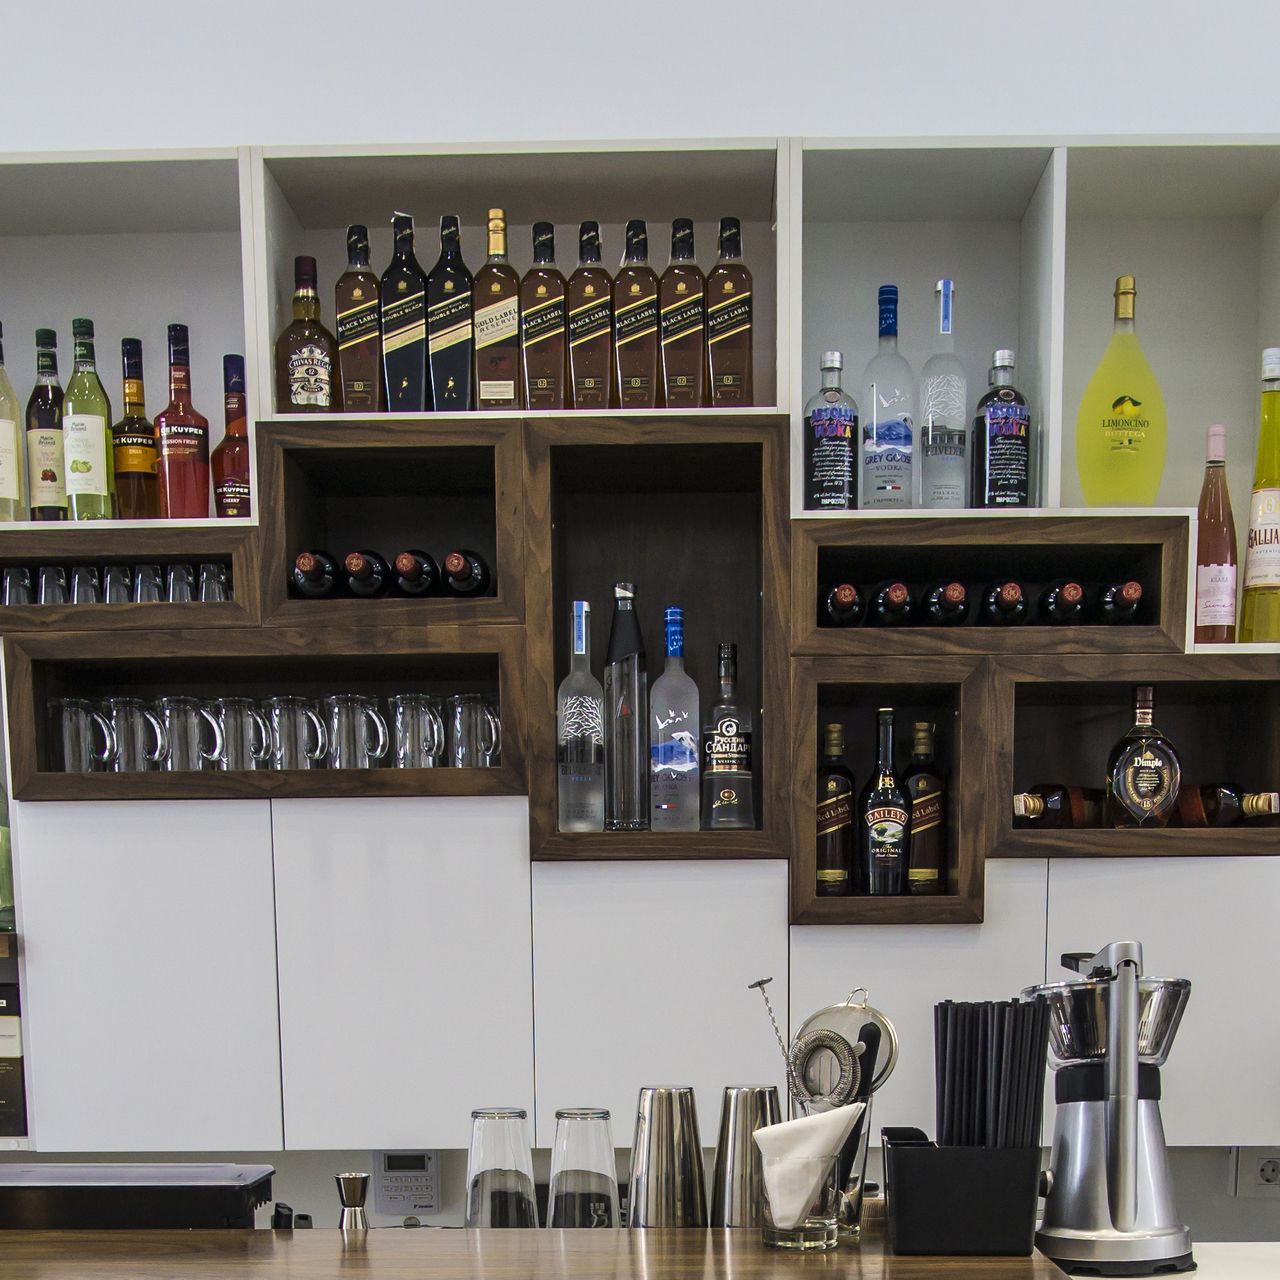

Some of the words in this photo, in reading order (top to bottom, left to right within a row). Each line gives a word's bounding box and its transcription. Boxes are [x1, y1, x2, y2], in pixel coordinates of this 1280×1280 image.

[451, 303, 470, 313] BLACK
[338, 320, 359, 333] BLACK
[359, 312, 378, 325] LABEL
[474, 317, 494, 329] GOLD
[494, 308, 518, 321] LABEL
[523, 318, 542, 329] BLACK
[542, 310, 562, 321] LABEL
[569, 316, 590, 329] BLACK
[590, 309, 610, 320] LABEL
[616, 316, 636, 328] BLACK
[636, 308, 656, 319] LABEL
[662, 315, 682, 327] BLACK
[682, 306, 703, 318] LABEL
[709, 313, 729, 327] BLACK
[730, 305, 749, 317] LABEL
[480, 315, 516, 333] RESERVE
[289, 358, 313, 369] CHIVAS
[313, 359, 332, 371] REGAL
[812, 407, 855, 421] ABSOLUT
[171, 425, 203, 435] KUYPER
[1102, 418, 1150, 428] LIMONCINO
[815, 424, 853, 438] VODKA
[121, 437, 153, 445] KUYPER
[864, 454, 884, 466] GREY
[885, 453, 913, 465] GOOSE
[875, 464, 903, 472] VODKA
[1133, 756, 1163, 769] Dimple
[830, 803, 850, 817] Label
[920, 802, 940, 816] Label
[1143, 800, 1151, 808] 15
[866, 809, 906, 822] BAILEYS
